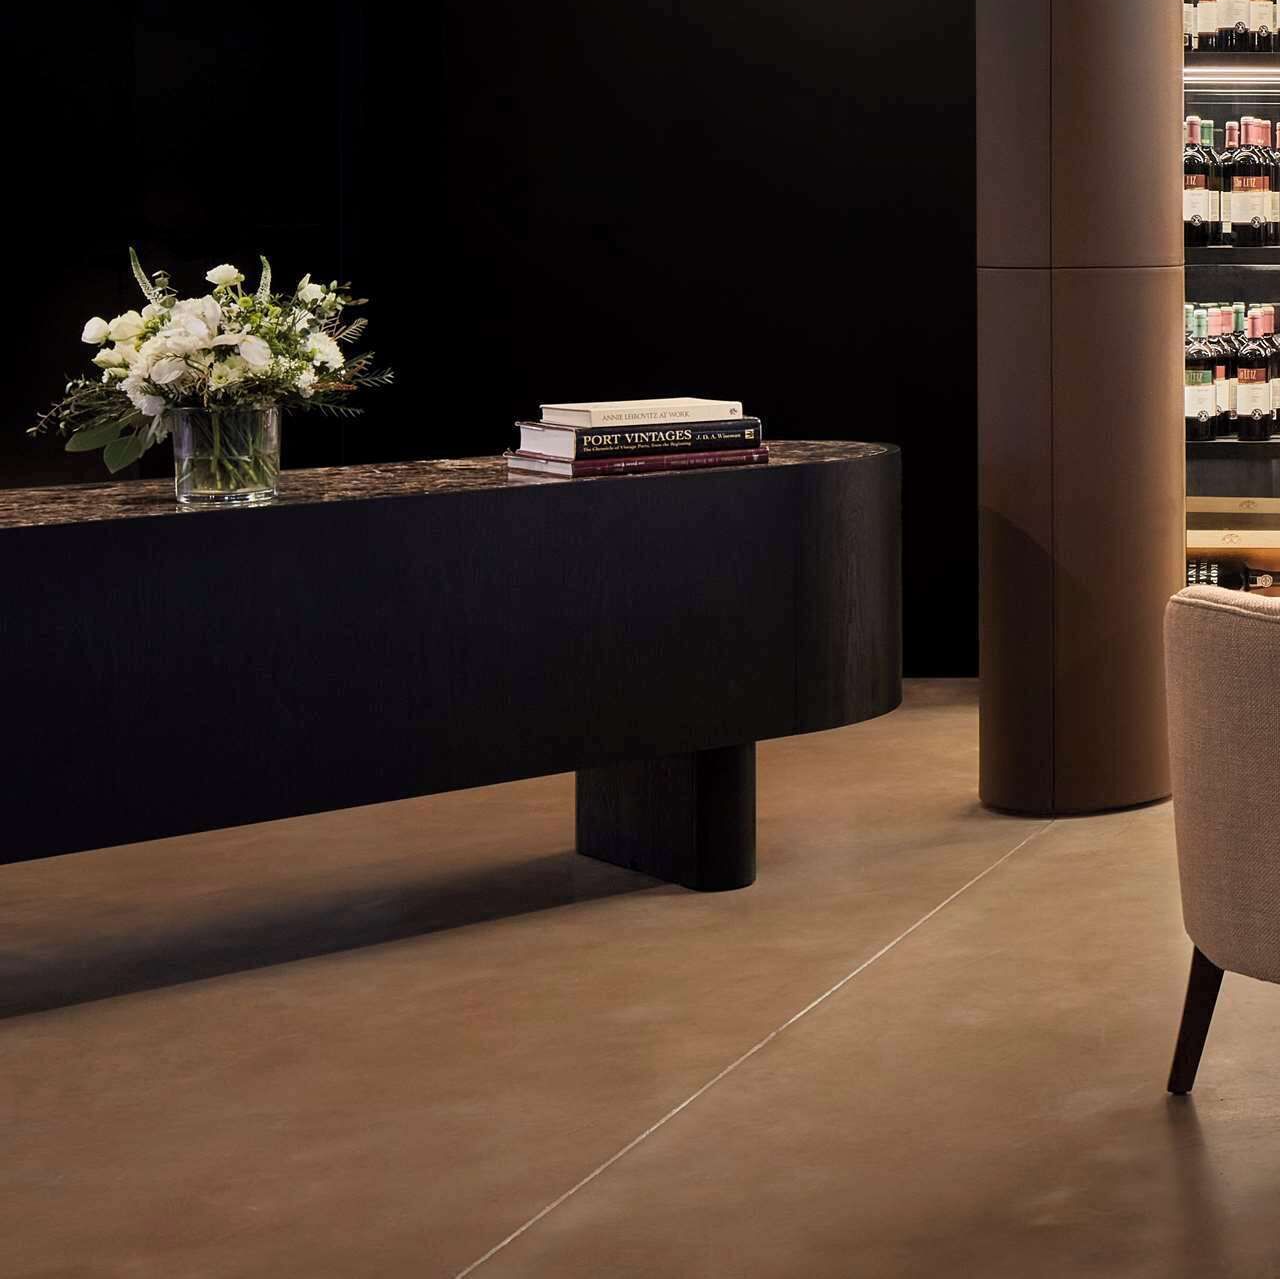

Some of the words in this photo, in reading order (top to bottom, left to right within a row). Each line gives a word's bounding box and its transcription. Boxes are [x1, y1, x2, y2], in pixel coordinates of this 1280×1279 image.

[602, 414, 623, 422] ANNIE
[625, 412, 657, 420] LEIBOVITZ
[583, 434, 620, 446] PORT
[625, 429, 692, 443] VINTAGES
